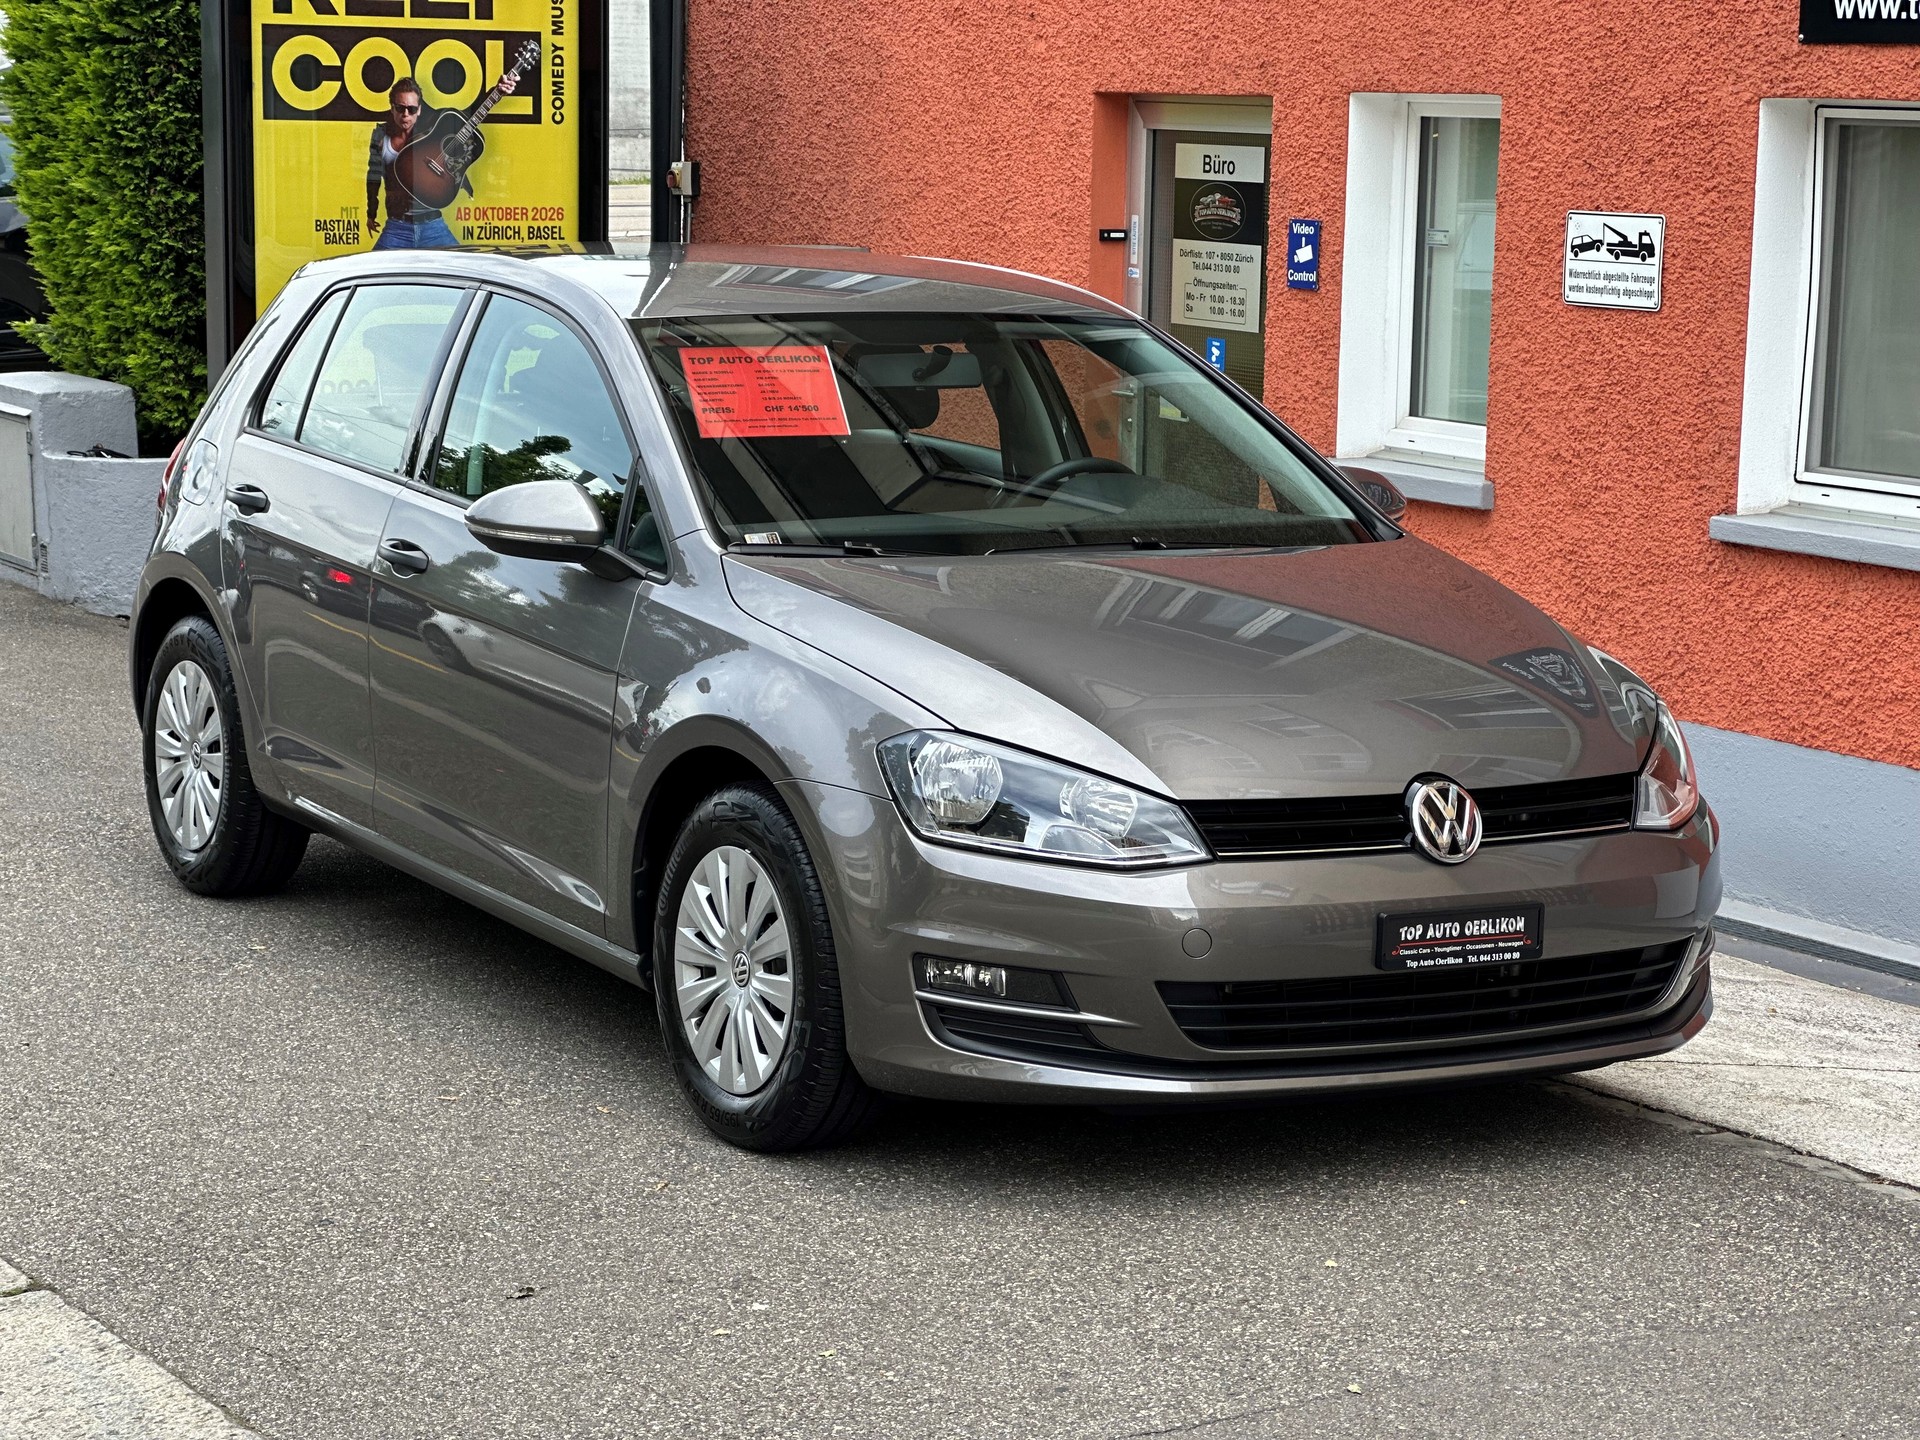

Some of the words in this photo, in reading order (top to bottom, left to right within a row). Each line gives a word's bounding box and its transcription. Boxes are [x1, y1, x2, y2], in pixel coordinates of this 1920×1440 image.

[1834, 0, 1920, 19] www.t
[271, 34, 533, 116] COOL
[551, 43, 565, 125] COMEDY
[1202, 154, 1236, 176] Büro
[340, 206, 360, 220] MIT
[455, 207, 472, 221] AB
[474, 207, 529, 221] OKTOBER
[531, 207, 565, 221] 2026
[314, 219, 360, 233] BASTIAN
[462, 227, 474, 241] IN
[476, 224, 525, 243] ZÜRICH,
[528, 226, 565, 241] BASEL
[1292, 223, 1315, 235] Video
[324, 232, 360, 245] BAKER
[1205, 251, 1216, 259] 107
[1220, 252, 1234, 261] 8050
[1235, 253, 1254, 263] Zürich
[1213, 263, 1224, 273] 313
[1224, 264, 1232, 273] 00
[1233, 265, 1240, 274] 80
[1287, 269, 1316, 282] Control
[1193, 277, 1239, 291] Öffnungszeiten:
[1568, 268, 1601, 280] Widerrechtlich
[1602, 270, 1629, 284] abgestellte
[1630, 272, 1656, 287] Fahrzeuge
[1185, 291, 1195, 301] Mo
[1199, 293, 1207, 302] Fr
[1209, 294, 1225, 304] 10.00
[1229, 296, 1245, 306] 18.30
[1568, 283, 1585, 293] werden
[1585, 283, 1621, 298] kostenpflichtig
[1622, 286, 1655, 301] abgeschleppt
[1185, 303, 1193, 312] Sa
[1209, 306, 1224, 316] 10.00
[1229, 308, 1245, 318] 16.00
[688, 357, 714, 365] TOP
[719, 356, 754, 364] AUTO
[757, 355, 822, 364] OERLIKON
[701, 406, 735, 414] PREIS:
[788, 404, 819, 412] 14'500
[1400, 924, 1423, 941] TOP
[1426, 921, 1460, 939] AUTO
[1464, 915, 1525, 936] OERLIKON
[1400, 948, 1418, 956] Classic
[1434, 945, 1463, 954] Youngtimer
[1498, 940, 1524, 949] Neuwagen
[1406, 960, 1418, 969] Top
[1419, 958, 1435, 967] Auto
[1435, 956, 1463, 966] Oerlikon
[1467, 955, 1479, 963] Tel.
[1479, 954, 1491, 962] 044
[1491, 953, 1503, 961] 313
[1504, 952, 1512, 960] 00
[1512, 951, 1520, 960] 80
